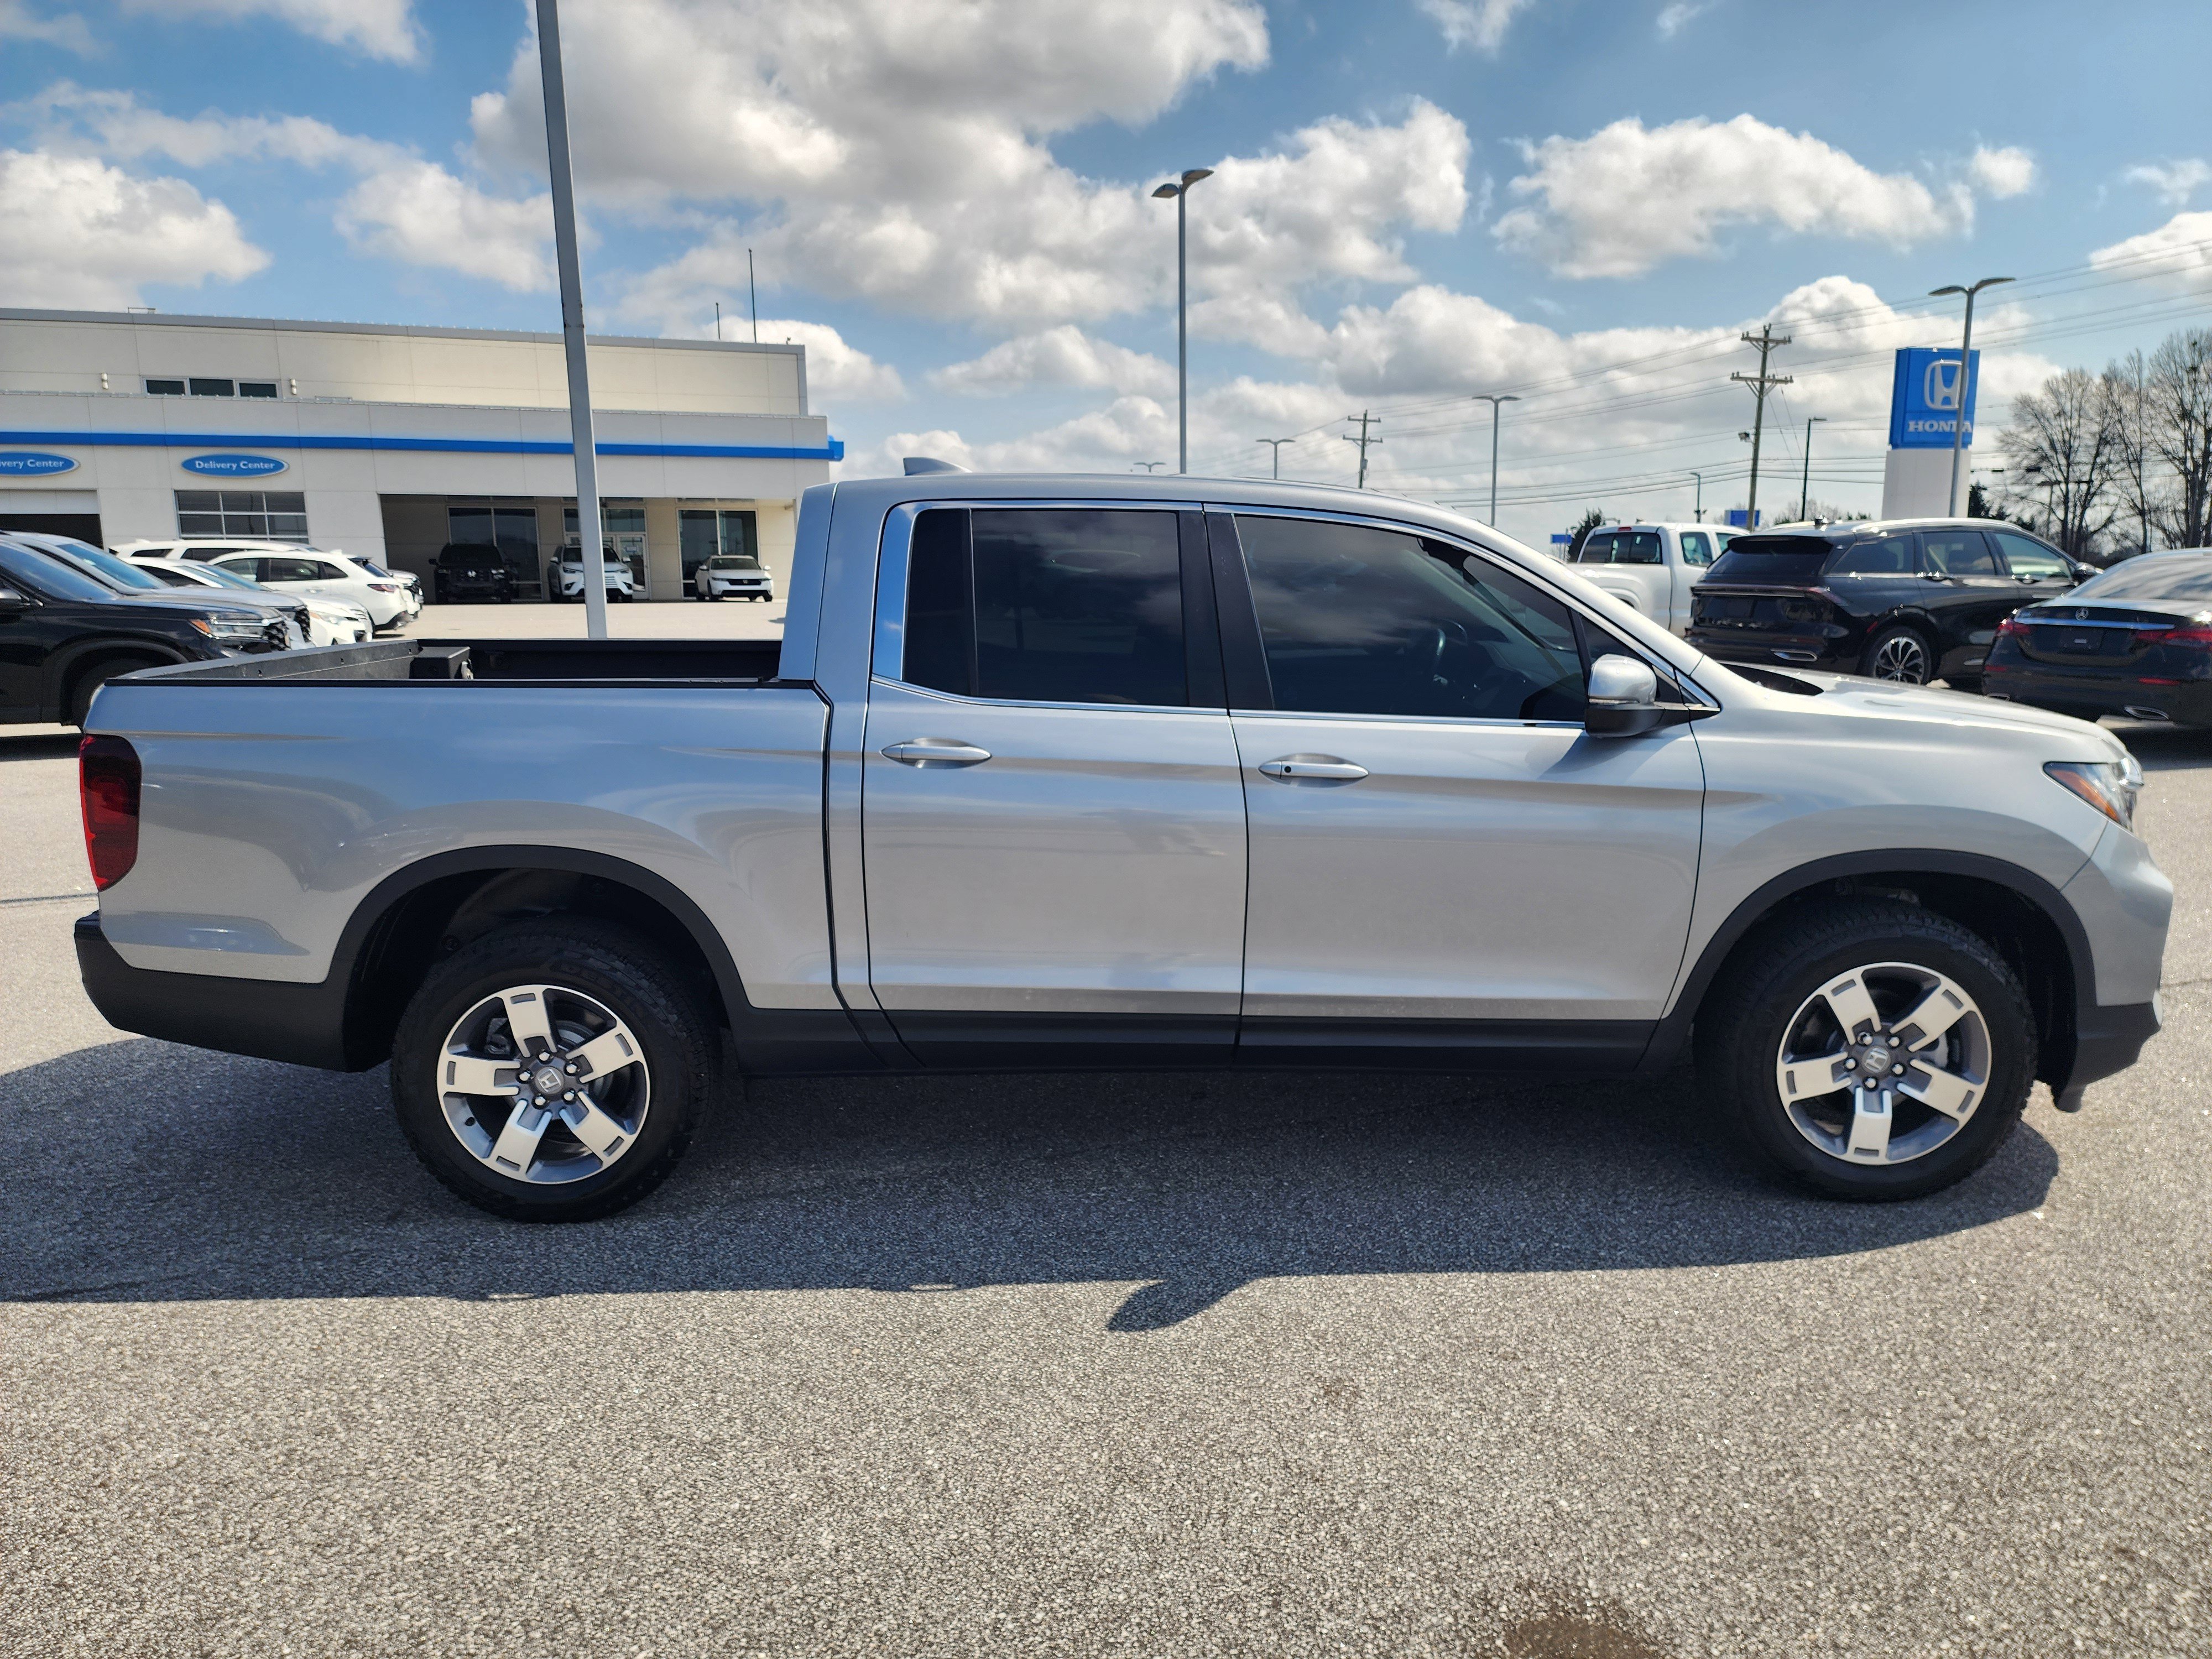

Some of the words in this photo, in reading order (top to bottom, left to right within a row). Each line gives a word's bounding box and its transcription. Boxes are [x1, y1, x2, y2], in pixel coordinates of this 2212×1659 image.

[27, 459, 64, 467] Center
[195, 461, 237, 471] Delivery
[239, 461, 275, 469] Center
